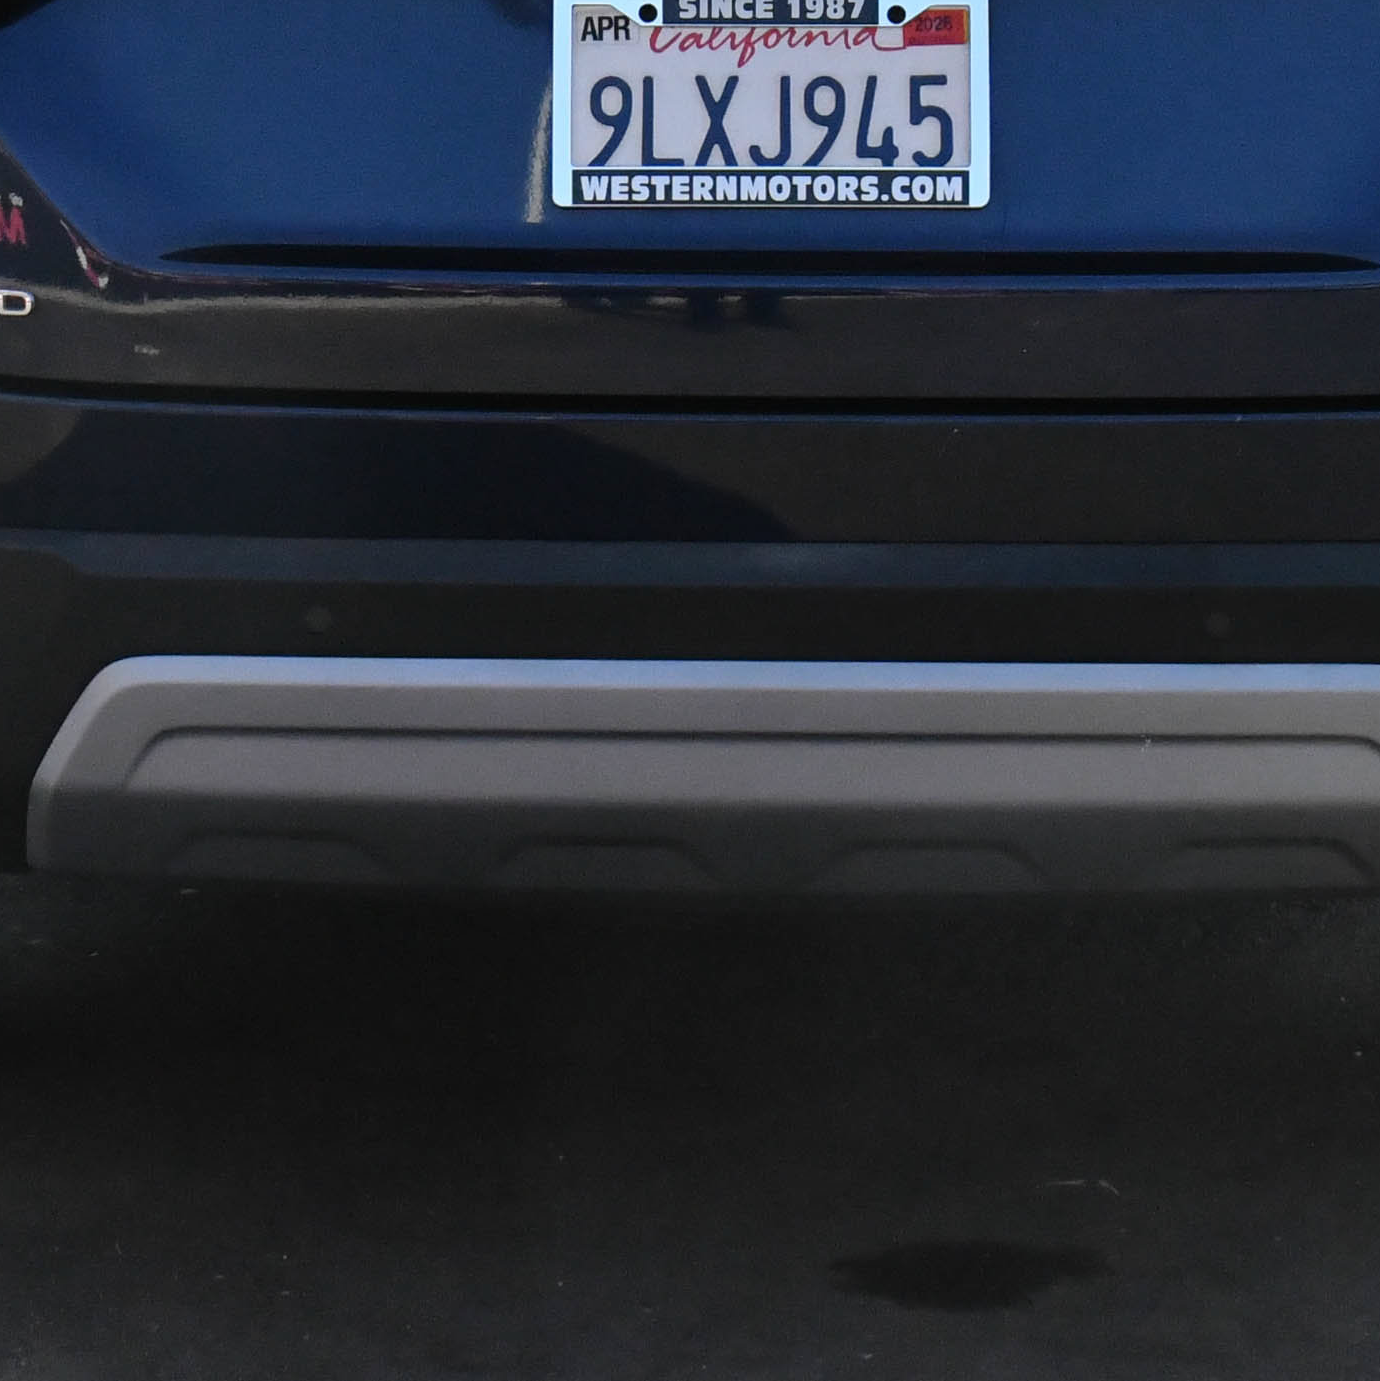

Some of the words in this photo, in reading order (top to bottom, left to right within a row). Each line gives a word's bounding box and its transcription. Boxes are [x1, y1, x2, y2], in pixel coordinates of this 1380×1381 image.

[580, 14, 632, 42] APR
[587, 74, 954, 167] 9LXJ945
[579, 175, 964, 202] WESTERNMOTORS.COM
